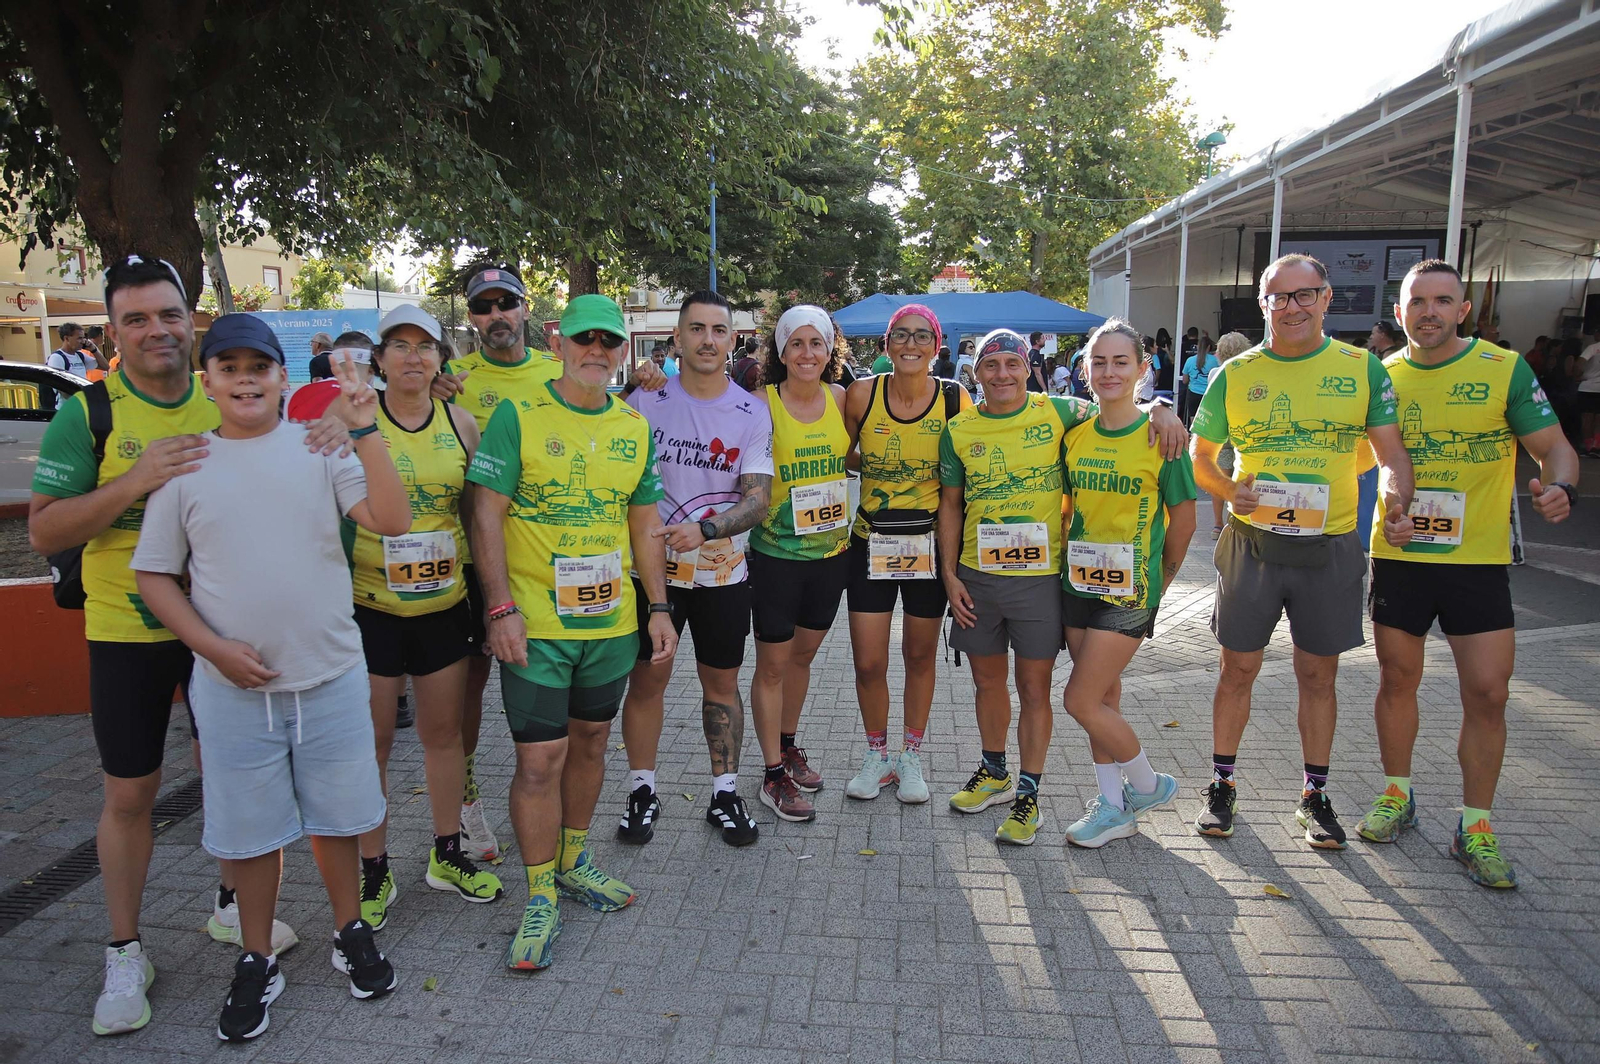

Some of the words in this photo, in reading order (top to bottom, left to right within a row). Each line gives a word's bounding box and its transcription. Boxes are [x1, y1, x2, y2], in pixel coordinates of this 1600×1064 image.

[279, 319, 310, 328] Verano
[311, 318, 333, 327] 2025
[668, 437, 709, 453] camino
[795, 445, 831, 458] RUNNERS
[659, 450, 674, 463] de
[1076, 457, 1115, 469] RUNNERS
[1284, 457, 1327, 468] BARRIOS
[779, 454, 846, 482] BARREÑO
[1415, 470, 1459, 481] BARRIOS
[804, 504, 842, 522] 162
[1138, 497, 1149, 519] VILLA
[1277, 509, 1296, 523] 4
[1412, 516, 1452, 532] 83
[989, 547, 1040, 561] 148
[666, 561, 678, 575] 2
[887, 556, 918, 568] 27
[1133, 549, 1143, 586] BARRIOS
[399, 560, 450, 579] 136
[1077, 567, 1124, 583] 149
[578, 582, 612, 602] 59
